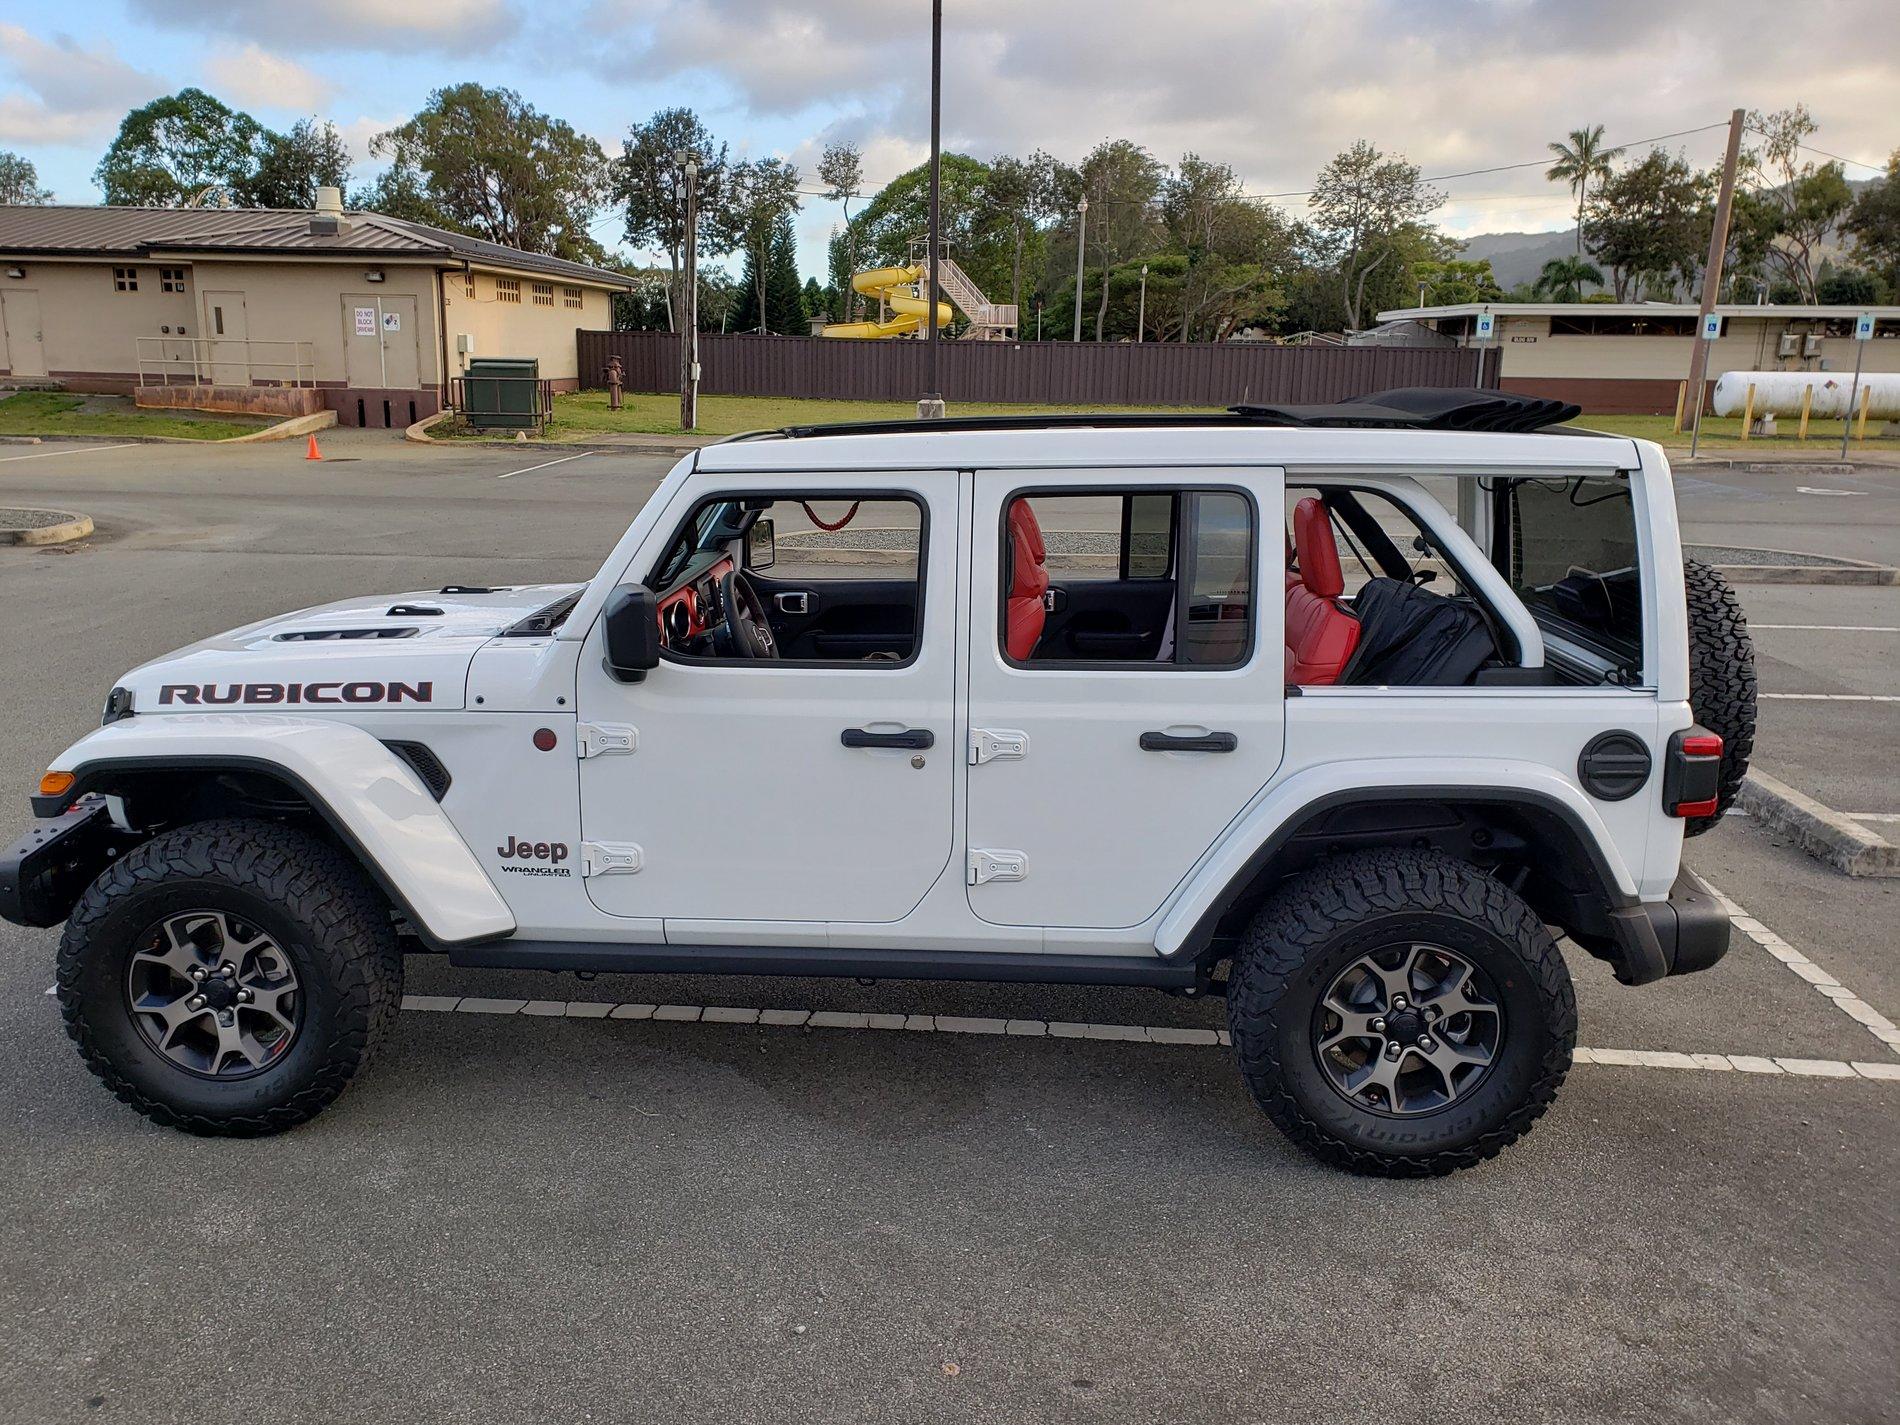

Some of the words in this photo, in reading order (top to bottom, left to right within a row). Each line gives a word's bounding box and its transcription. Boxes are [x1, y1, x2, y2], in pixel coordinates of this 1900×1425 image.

[158, 681, 433, 705] RUBICON
[497, 835, 568, 864] Jeep
[501, 865, 570, 874] WRANGLER
